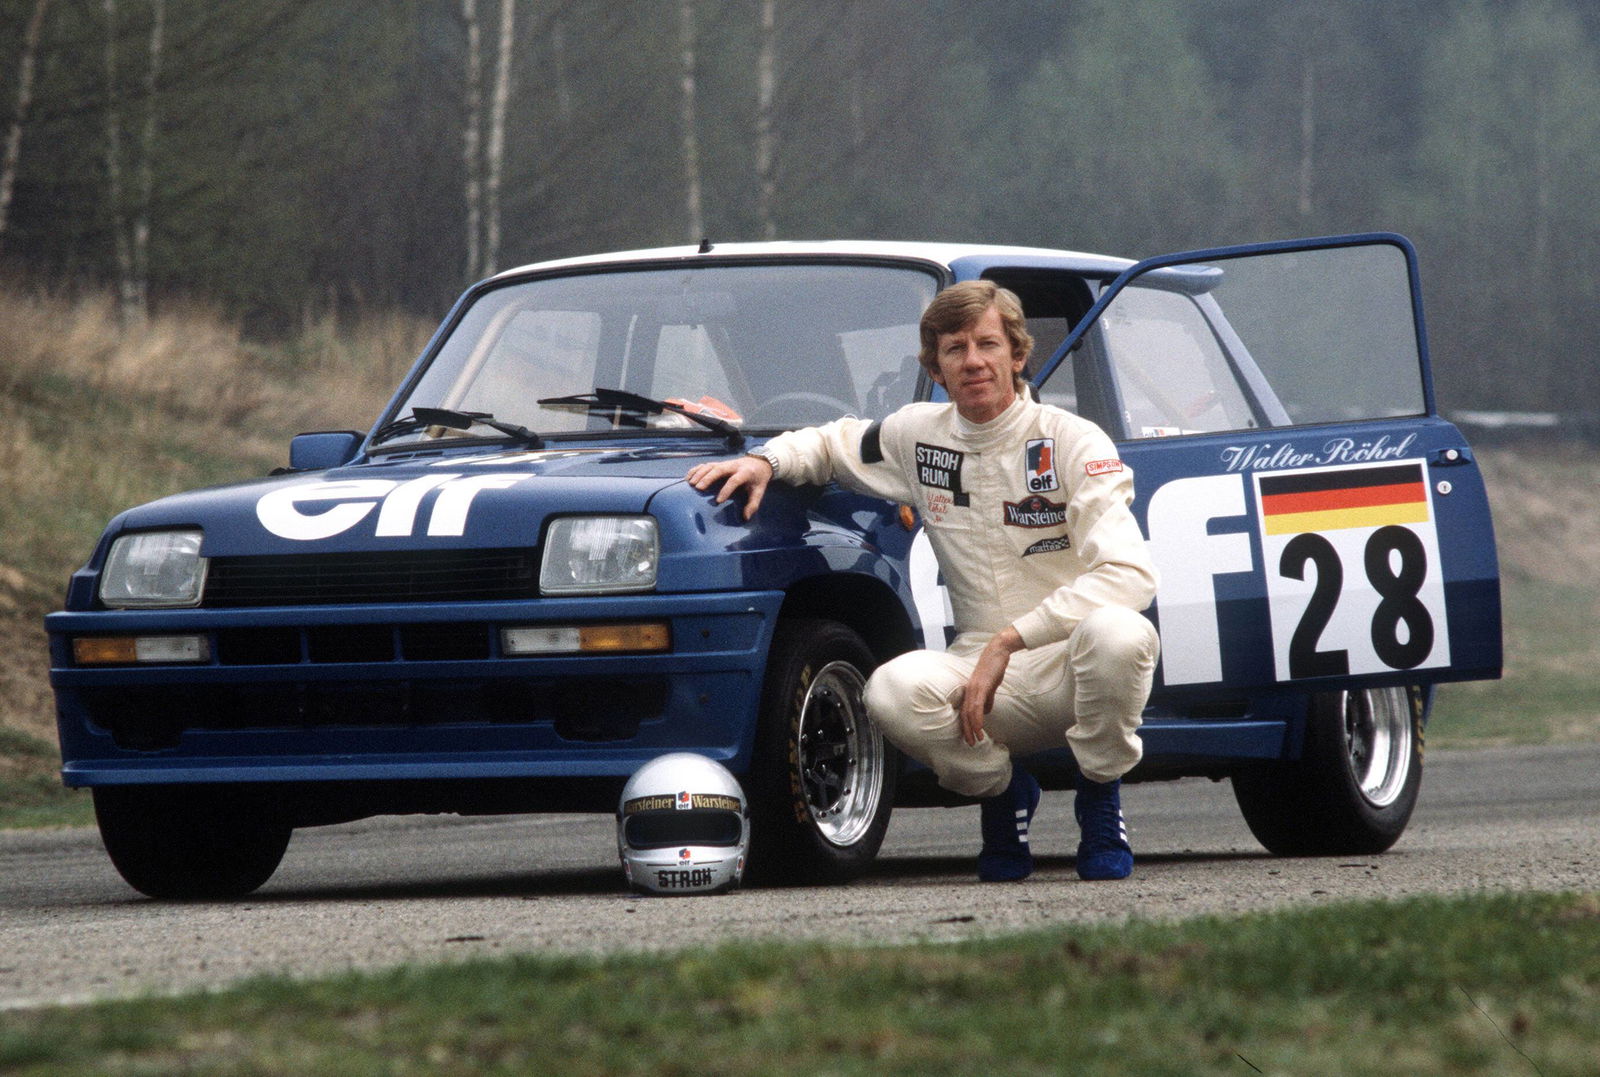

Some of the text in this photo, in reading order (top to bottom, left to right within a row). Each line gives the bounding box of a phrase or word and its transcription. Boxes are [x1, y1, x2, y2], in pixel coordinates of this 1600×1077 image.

[916, 446, 959, 470] STROH
[1220, 433, 1417, 472] Walter Röhrl
[921, 466, 949, 487] RUM
[1029, 474, 1053, 490] elf
[1279, 524, 1434, 679] 28
[658, 868, 712, 888] STROH
